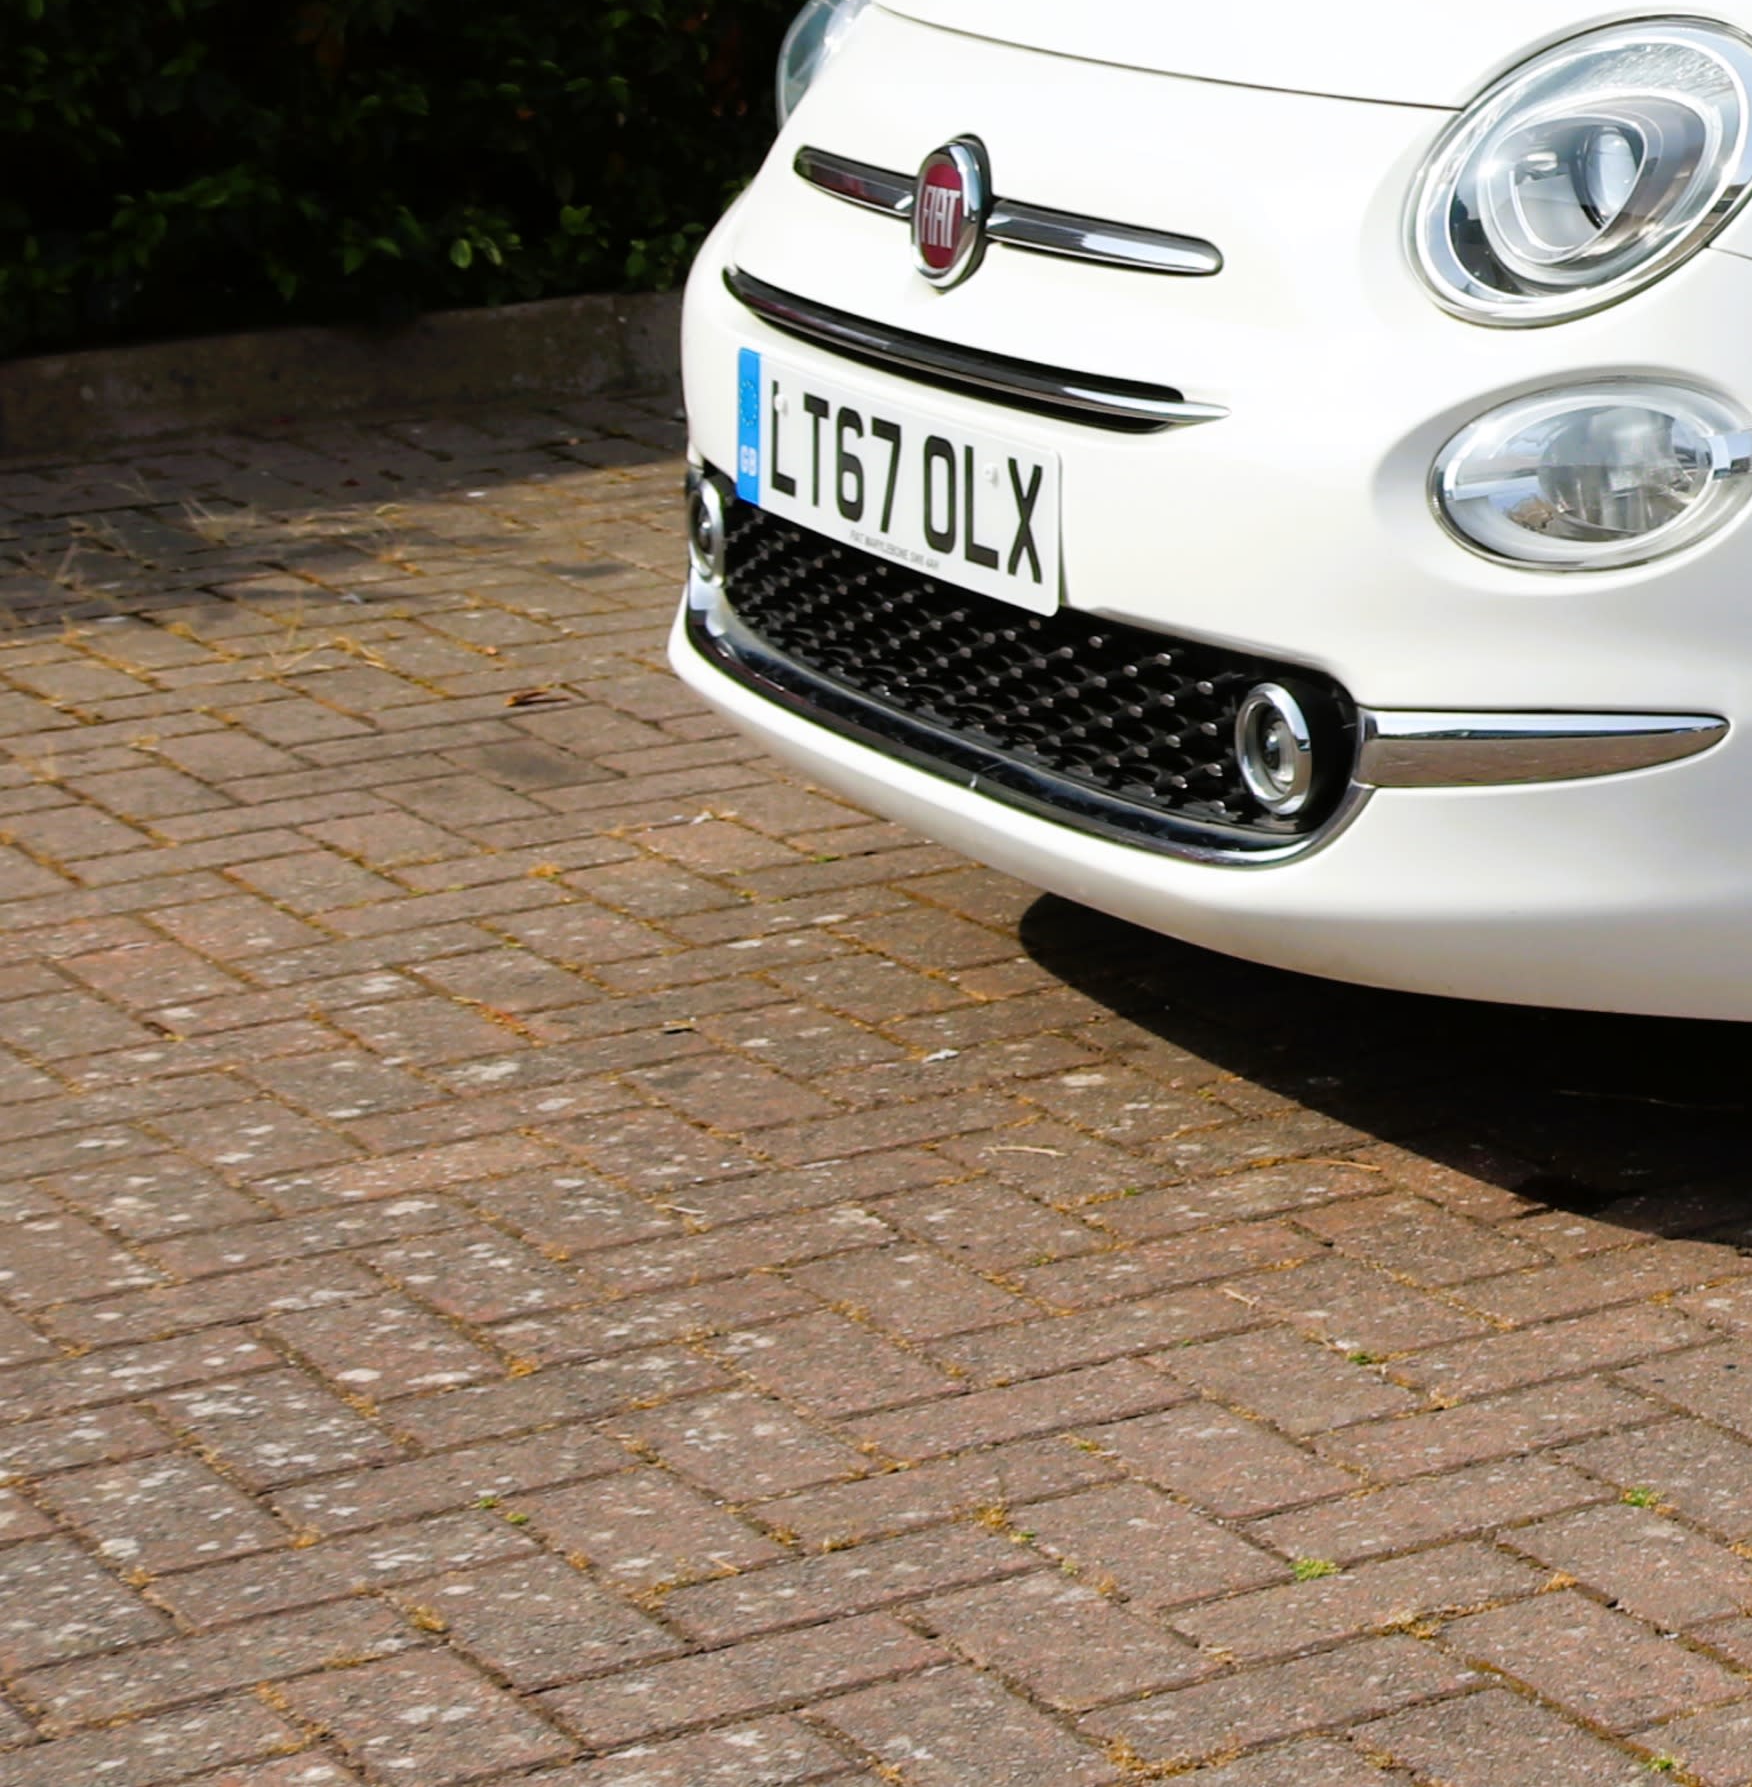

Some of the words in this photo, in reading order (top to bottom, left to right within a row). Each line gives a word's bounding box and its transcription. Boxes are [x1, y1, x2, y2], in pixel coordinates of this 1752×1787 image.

[921, 185, 961, 248] FIAT
[770, 379, 902, 535] LT67
[922, 434, 1044, 585] OLX
